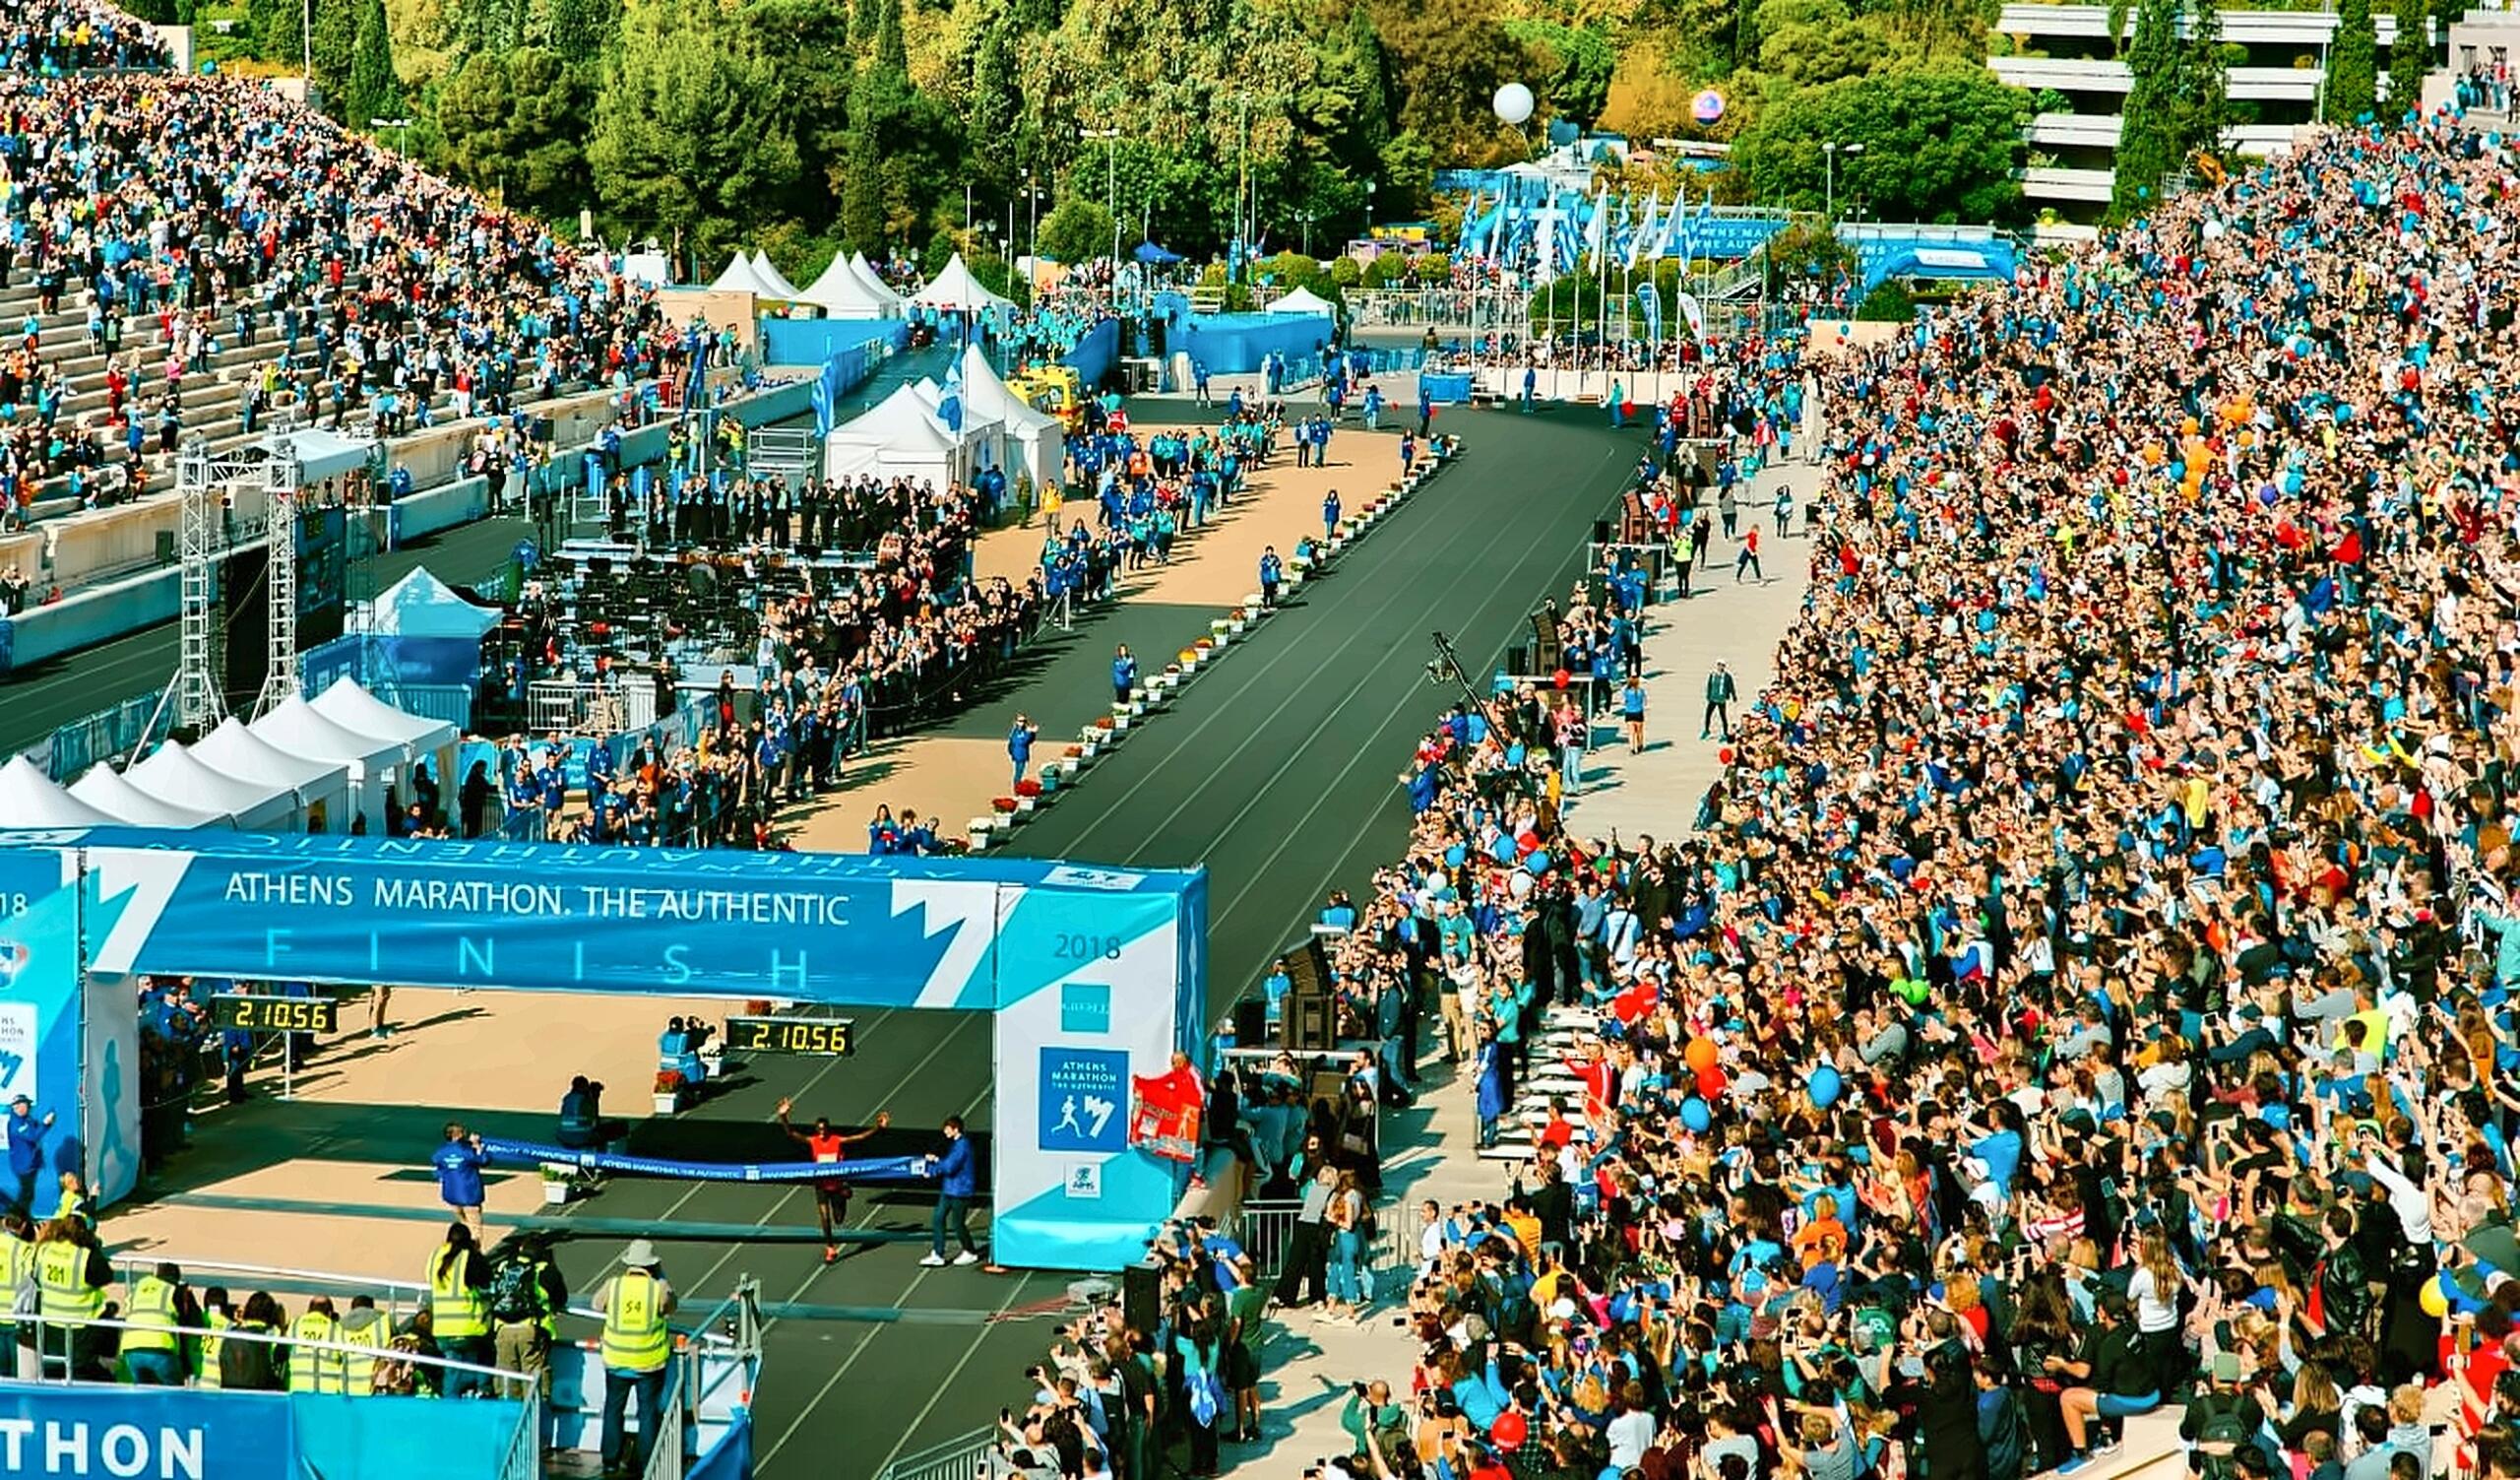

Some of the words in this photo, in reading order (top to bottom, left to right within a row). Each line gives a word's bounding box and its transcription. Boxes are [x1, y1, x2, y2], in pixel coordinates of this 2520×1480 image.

[224, 872, 353, 906] ATHENS
[374, 877, 572, 916] MARATHON.
[582, 885, 646, 918] THE
[657, 888, 850, 926] AUTHENTIC
[267, 928, 807, 989] FINISH
[1053, 933, 1121, 960] 2018
[236, 1001, 327, 1029] 2.10.56
[753, 1024, 846, 1052] 2.10.56
[1050, 1071, 1117, 1084] MARATHON
[1061, 1061, 1107, 1072] ATHENS
[0, 1418, 204, 1480] THON
